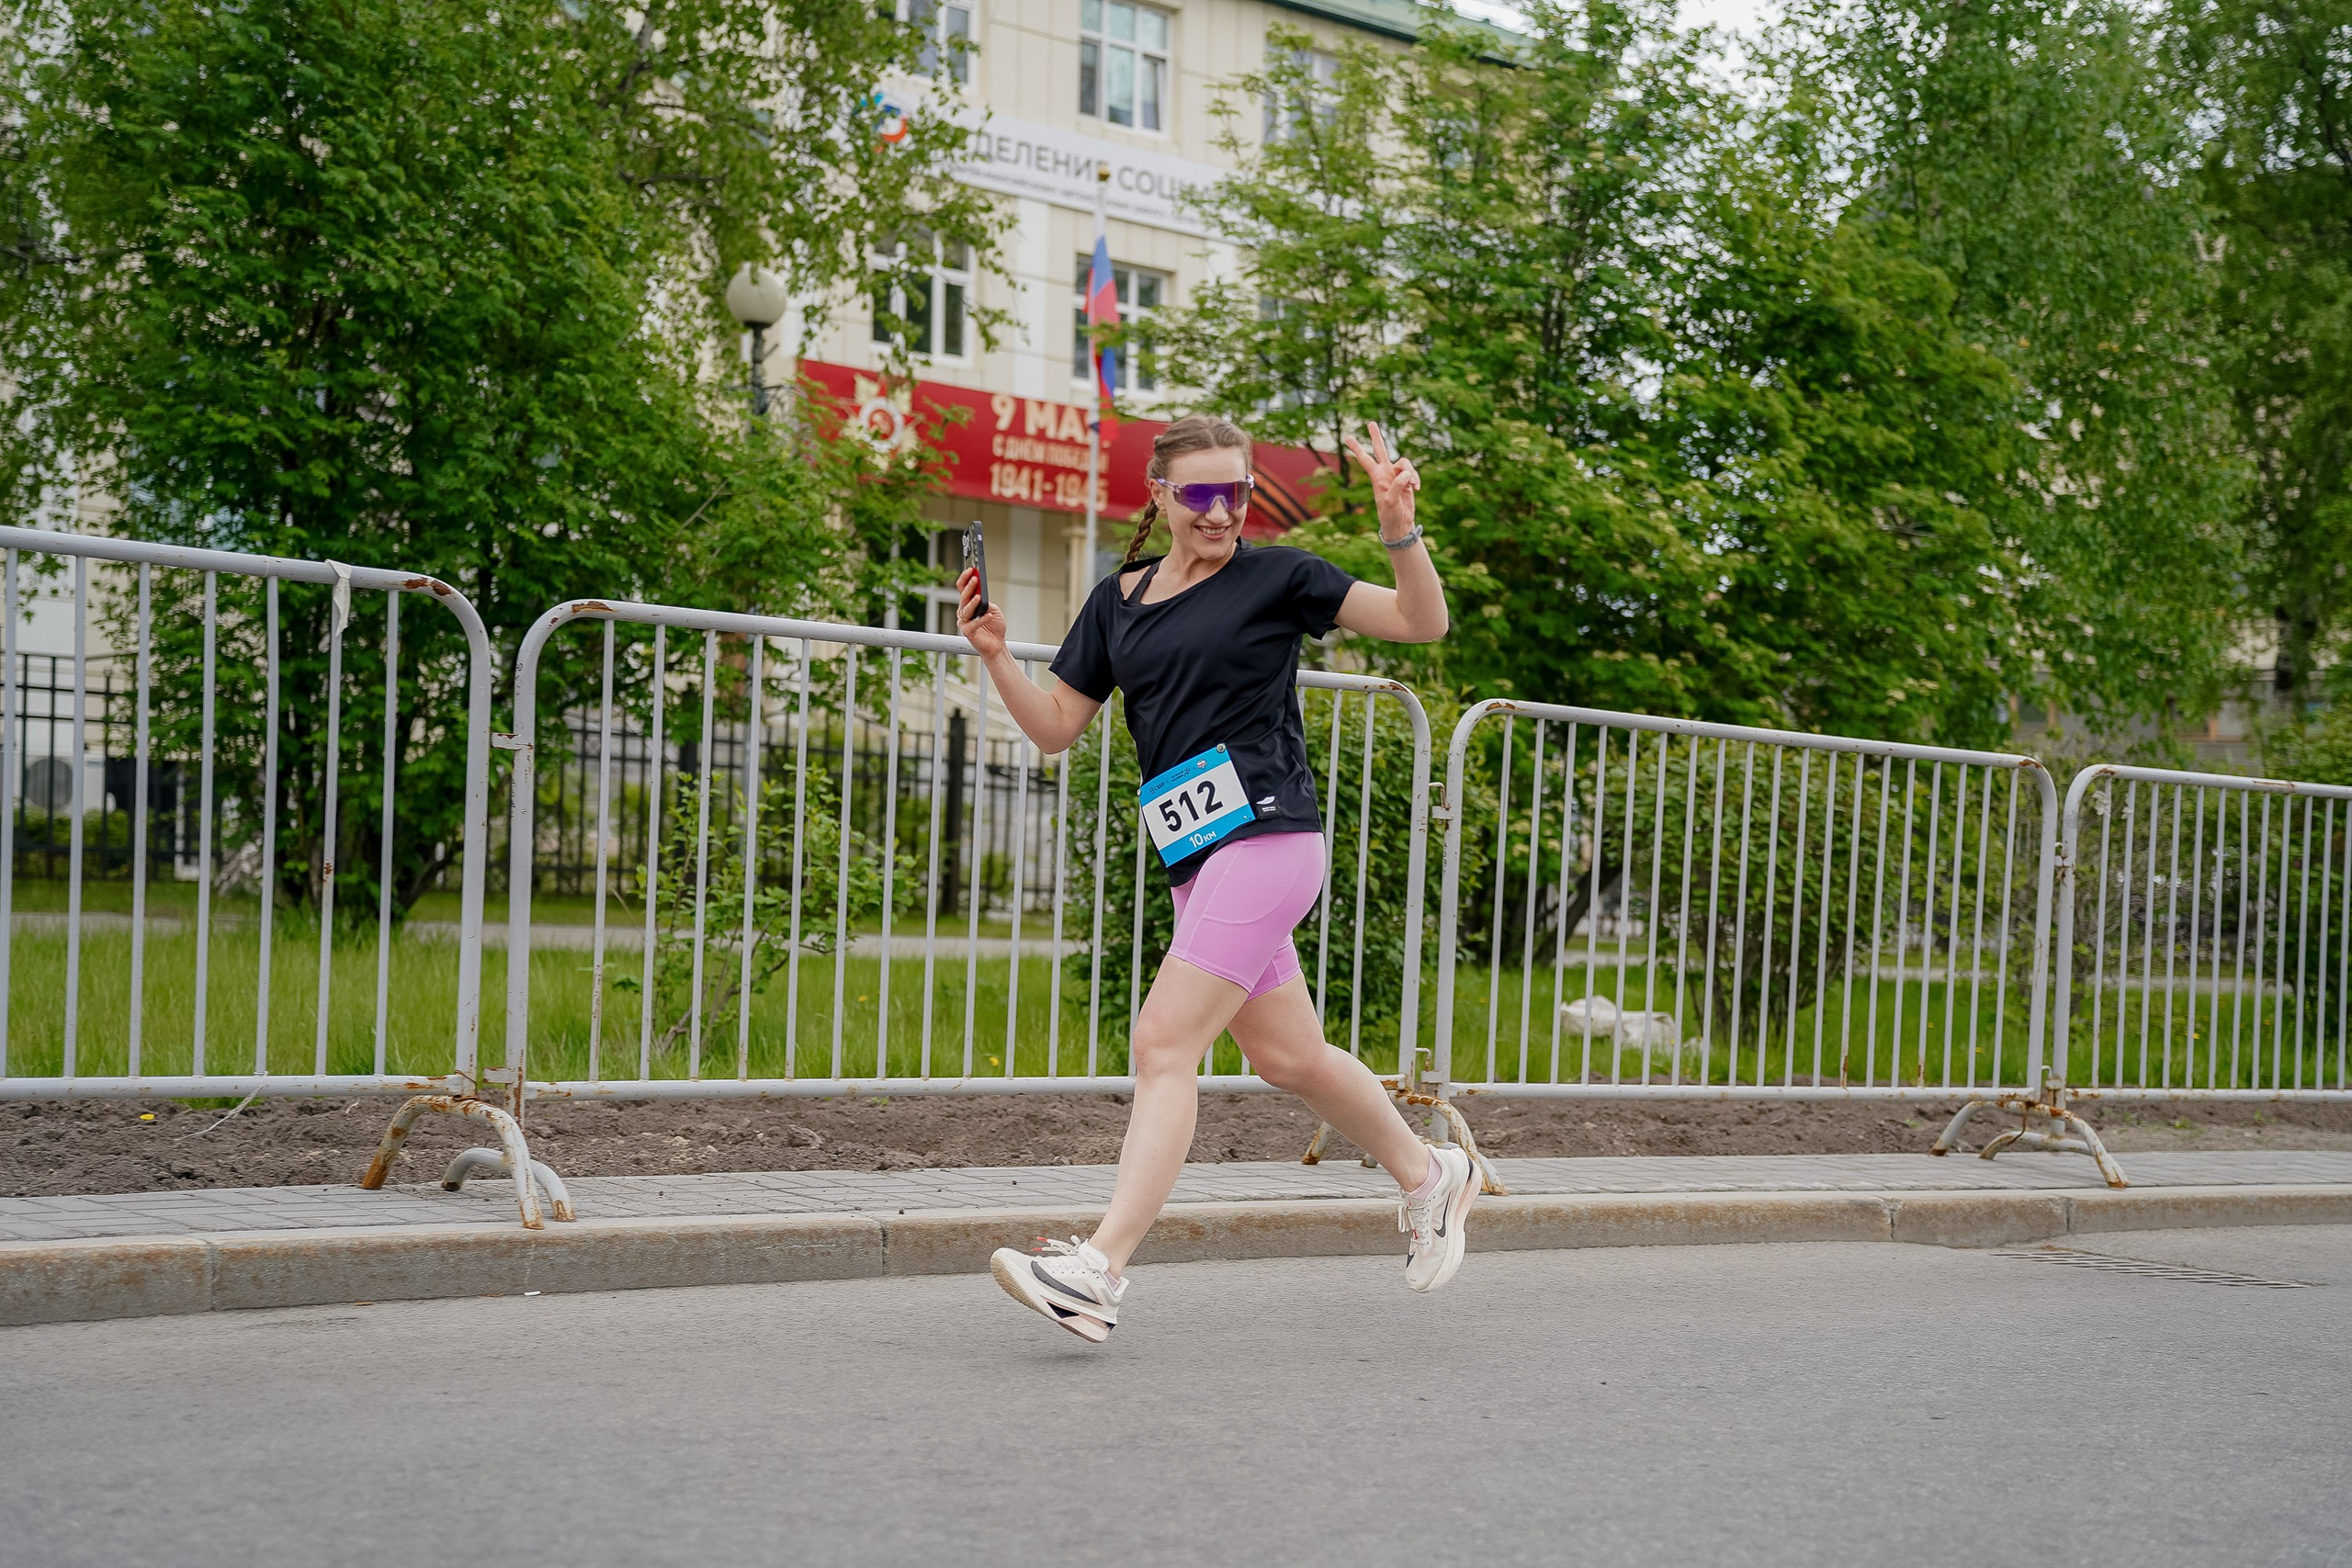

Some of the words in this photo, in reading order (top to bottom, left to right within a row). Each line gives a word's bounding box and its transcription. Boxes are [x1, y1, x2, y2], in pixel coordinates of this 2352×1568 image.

[991, 393, 1016, 431] 9
[1024, 399, 1112, 449] МА
[992, 433, 1005, 457] С
[1159, 780, 1224, 833] 512
